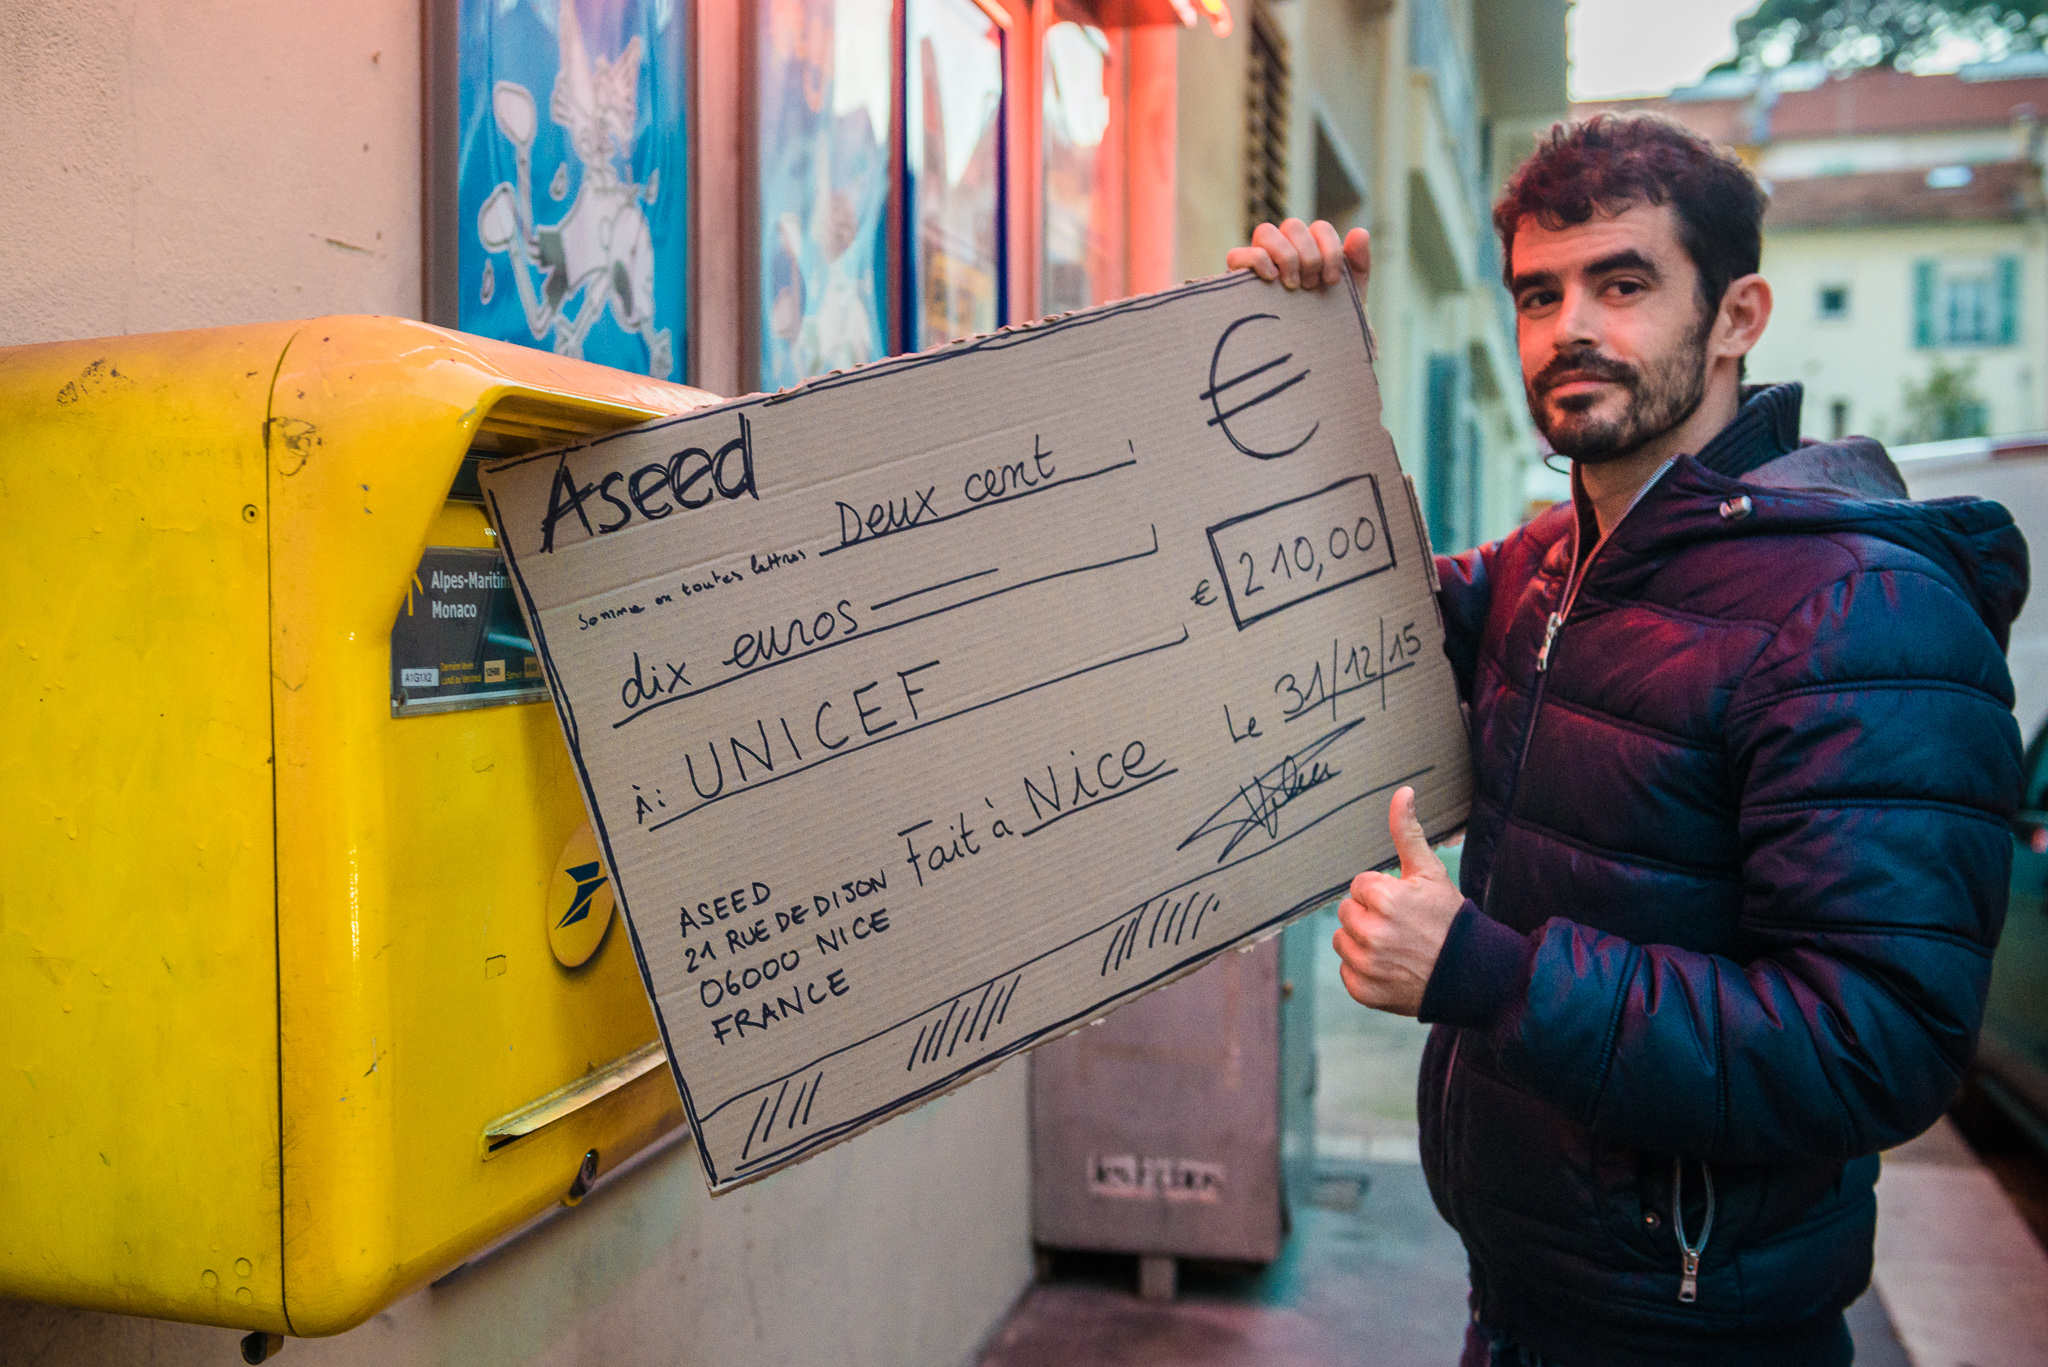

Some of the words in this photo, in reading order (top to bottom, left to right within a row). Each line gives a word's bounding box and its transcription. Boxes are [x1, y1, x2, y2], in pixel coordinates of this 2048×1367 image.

[539, 412, 760, 553] Aseed
[682, 570, 744, 596] toutes
[750, 550, 807, 575] lettres
[835, 485, 938, 548] Deux
[964, 433, 1056, 502] cent
[432, 600, 477, 619] Monaco
[1190, 579, 1218, 606] €
[1239, 516, 1375, 597] 210,00
[622, 652, 692, 709] dix
[722, 599, 858, 669] euros
[685, 660, 940, 799] UNICEF
[897, 812, 981, 887] Fait
[984, 797, 1014, 838] à
[1023, 741, 1166, 820] Nice
[1224, 704, 1263, 743] Le
[1275, 617, 1421, 722] 31/12/15
[680, 882, 771, 938] ASEED
[685, 941, 717, 974] 21
[725, 919, 771, 955] RUE
[775, 905, 809, 933] DE
[813, 869, 887, 918] DIJON
[700, 949, 800, 1008] 06000
[816, 908, 890, 955] NICE
[711, 968, 850, 1046] FRANCE
